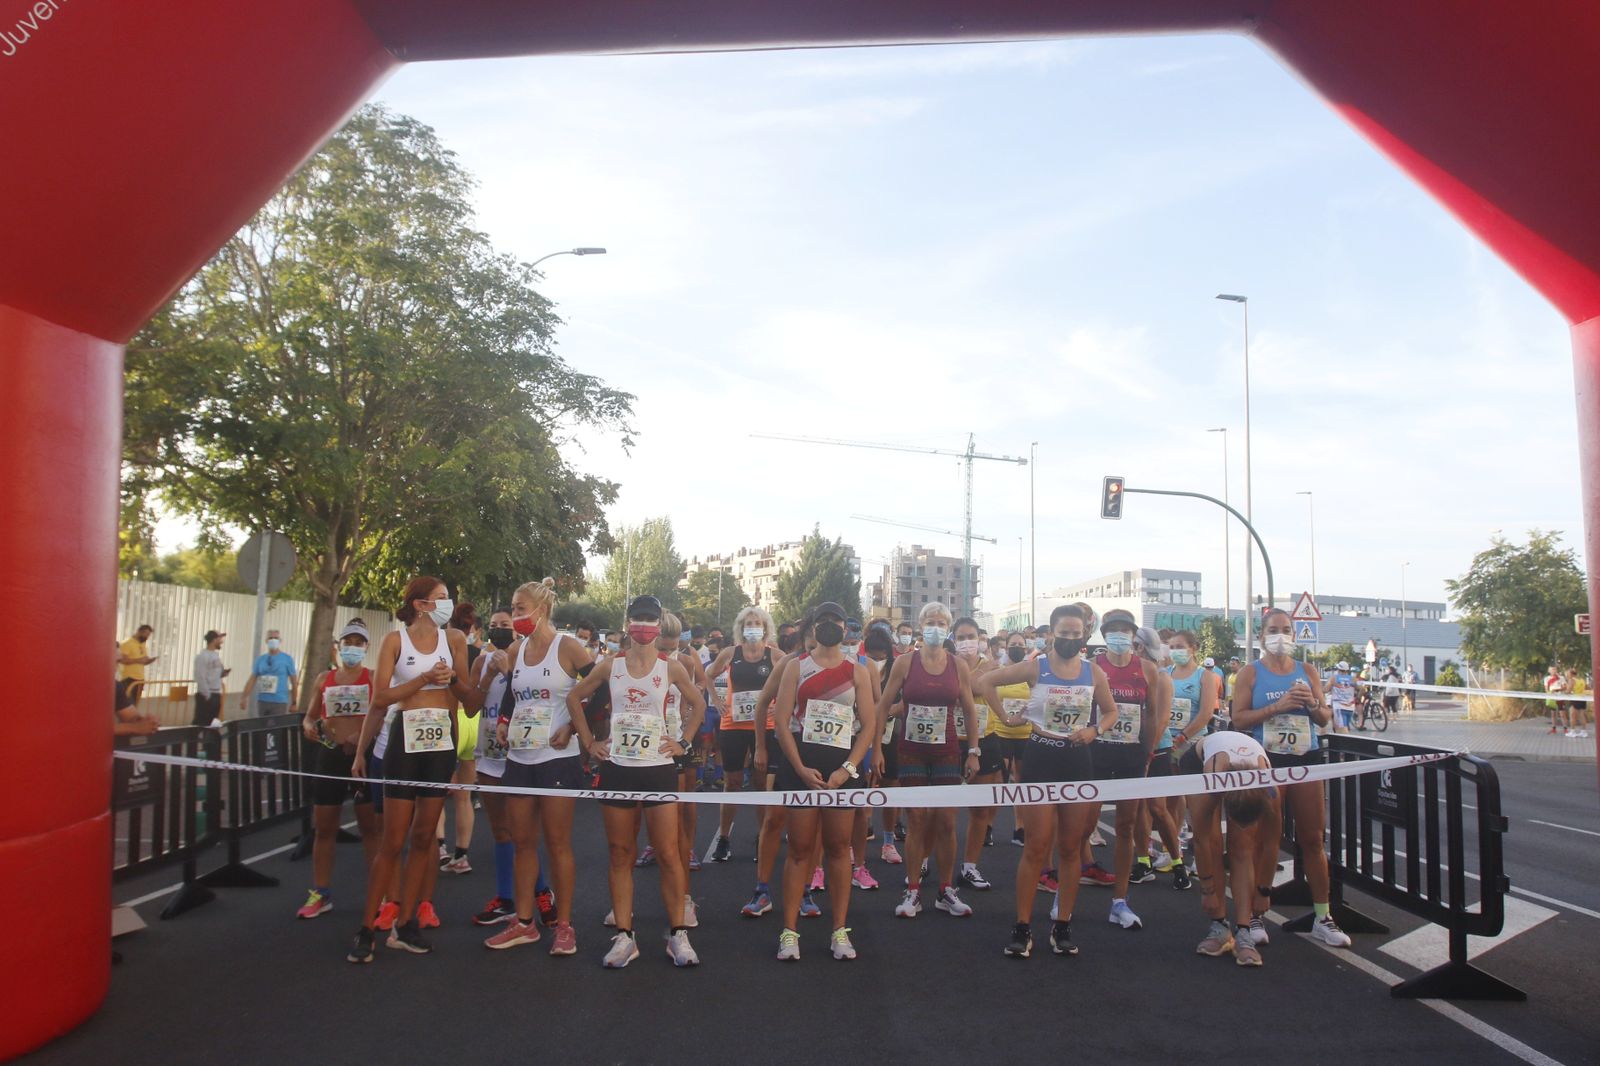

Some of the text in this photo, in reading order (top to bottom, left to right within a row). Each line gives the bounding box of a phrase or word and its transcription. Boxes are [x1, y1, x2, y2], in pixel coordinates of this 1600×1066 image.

[513, 686, 550, 702] indea
[334, 701, 361, 713] 242
[1052, 711, 1081, 726] 507
[415, 727, 443, 741] 289
[524, 726, 532, 738] 7
[813, 720, 844, 736] 307
[917, 723, 933, 735] 95
[1108, 721, 1132, 734] 46
[621, 733, 650, 749] 176
[1038, 737, 1065, 748] PRO
[1278, 732, 1297, 745] 70
[1203, 767, 1309, 791] IMDECO
[782, 789, 888, 806] IMDECO
[992, 783, 1099, 804] IMDECO
